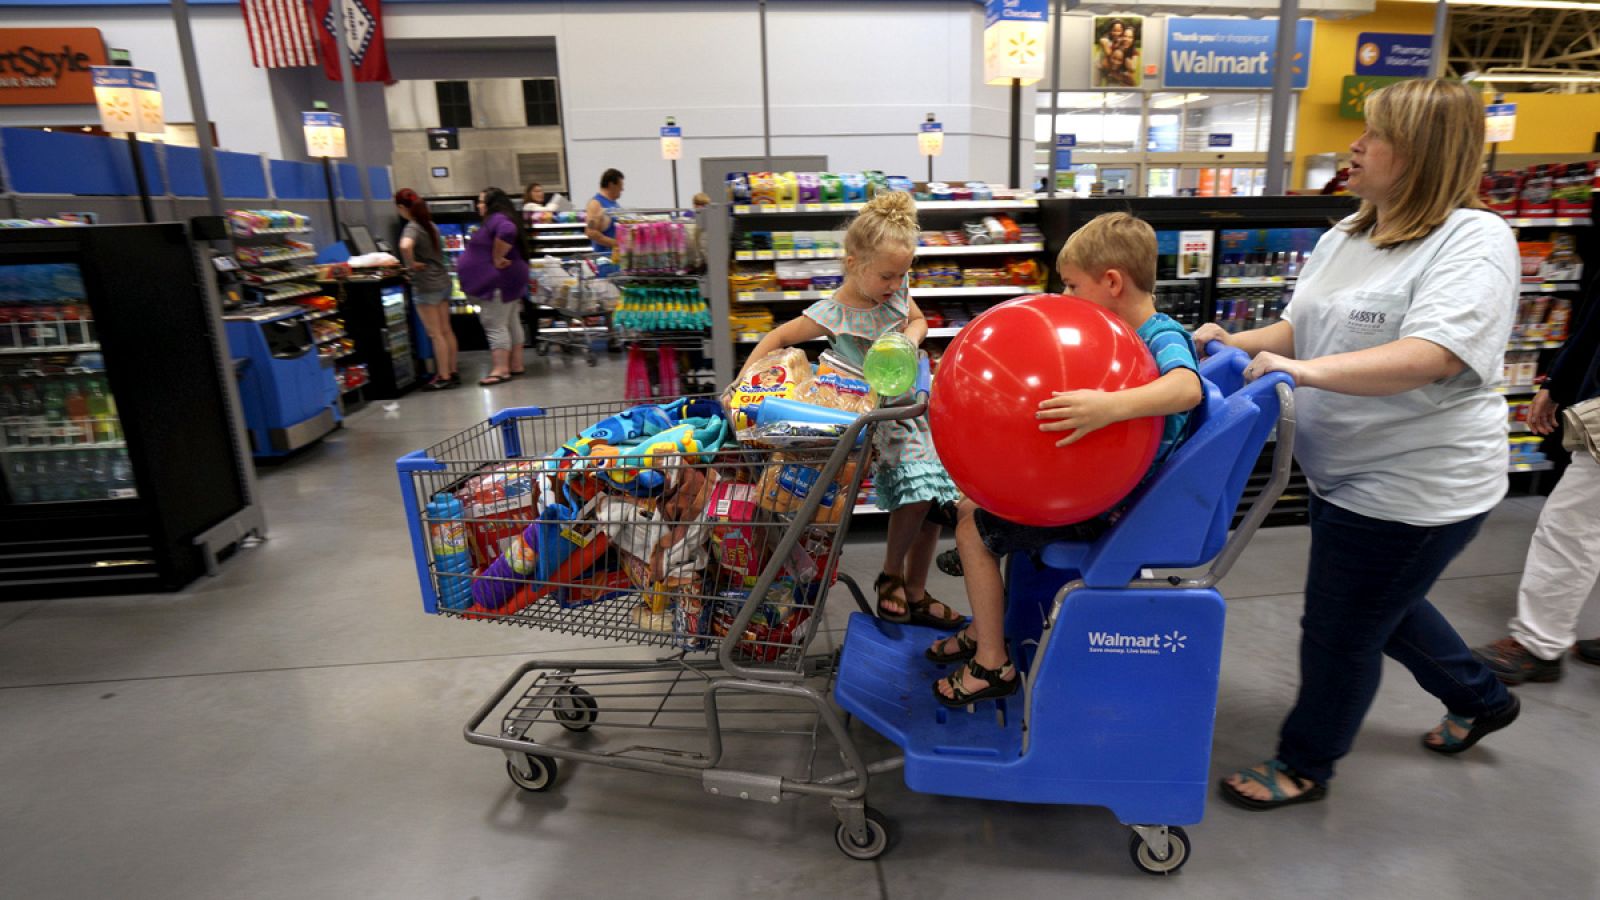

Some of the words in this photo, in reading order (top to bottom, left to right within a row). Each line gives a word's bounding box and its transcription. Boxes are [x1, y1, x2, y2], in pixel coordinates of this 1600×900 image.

[1172, 32, 1197, 41] Thank
[1171, 49, 1269, 75] Walmart
[1088, 632, 1160, 648] Walmart
